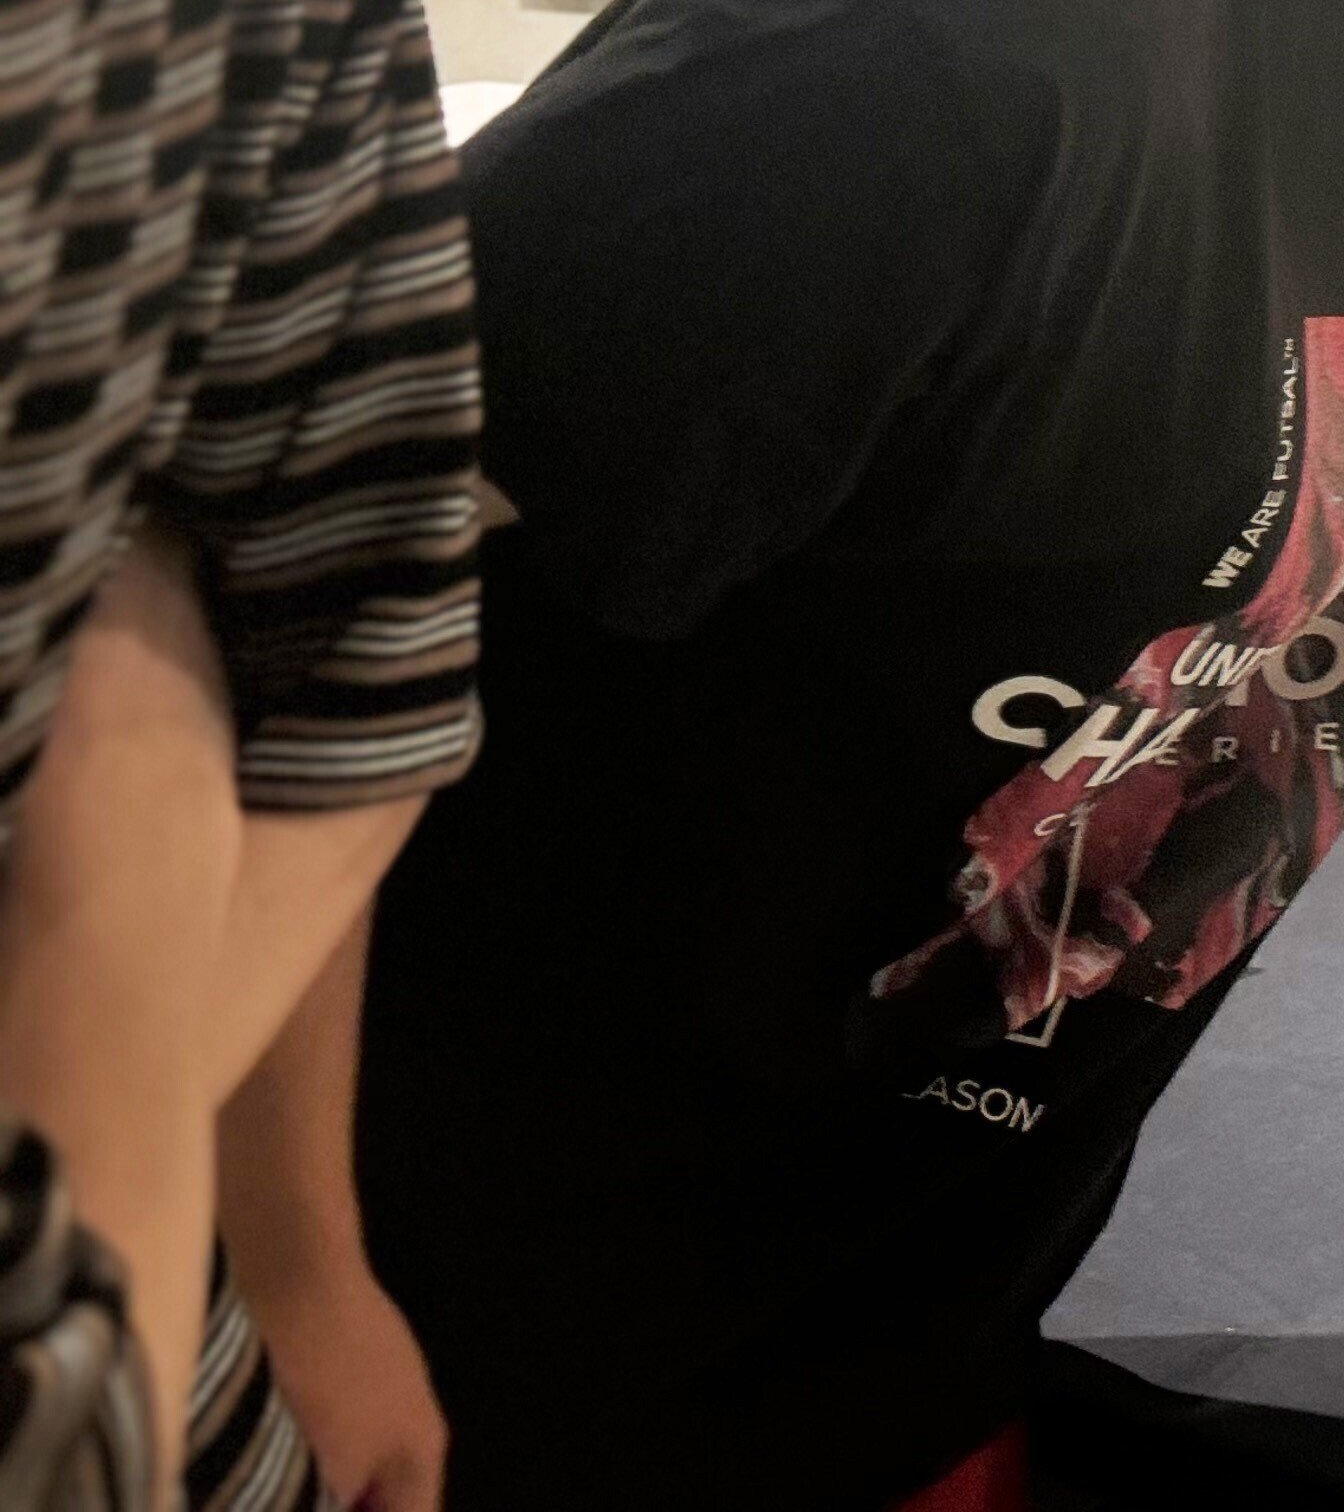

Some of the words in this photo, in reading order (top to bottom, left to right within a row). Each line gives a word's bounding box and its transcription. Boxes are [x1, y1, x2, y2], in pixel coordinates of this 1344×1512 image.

[1202, 545, 1253, 588] WE
[1242, 489, 1286, 548] ARE
[901, 1075, 1047, 1133] ASON
